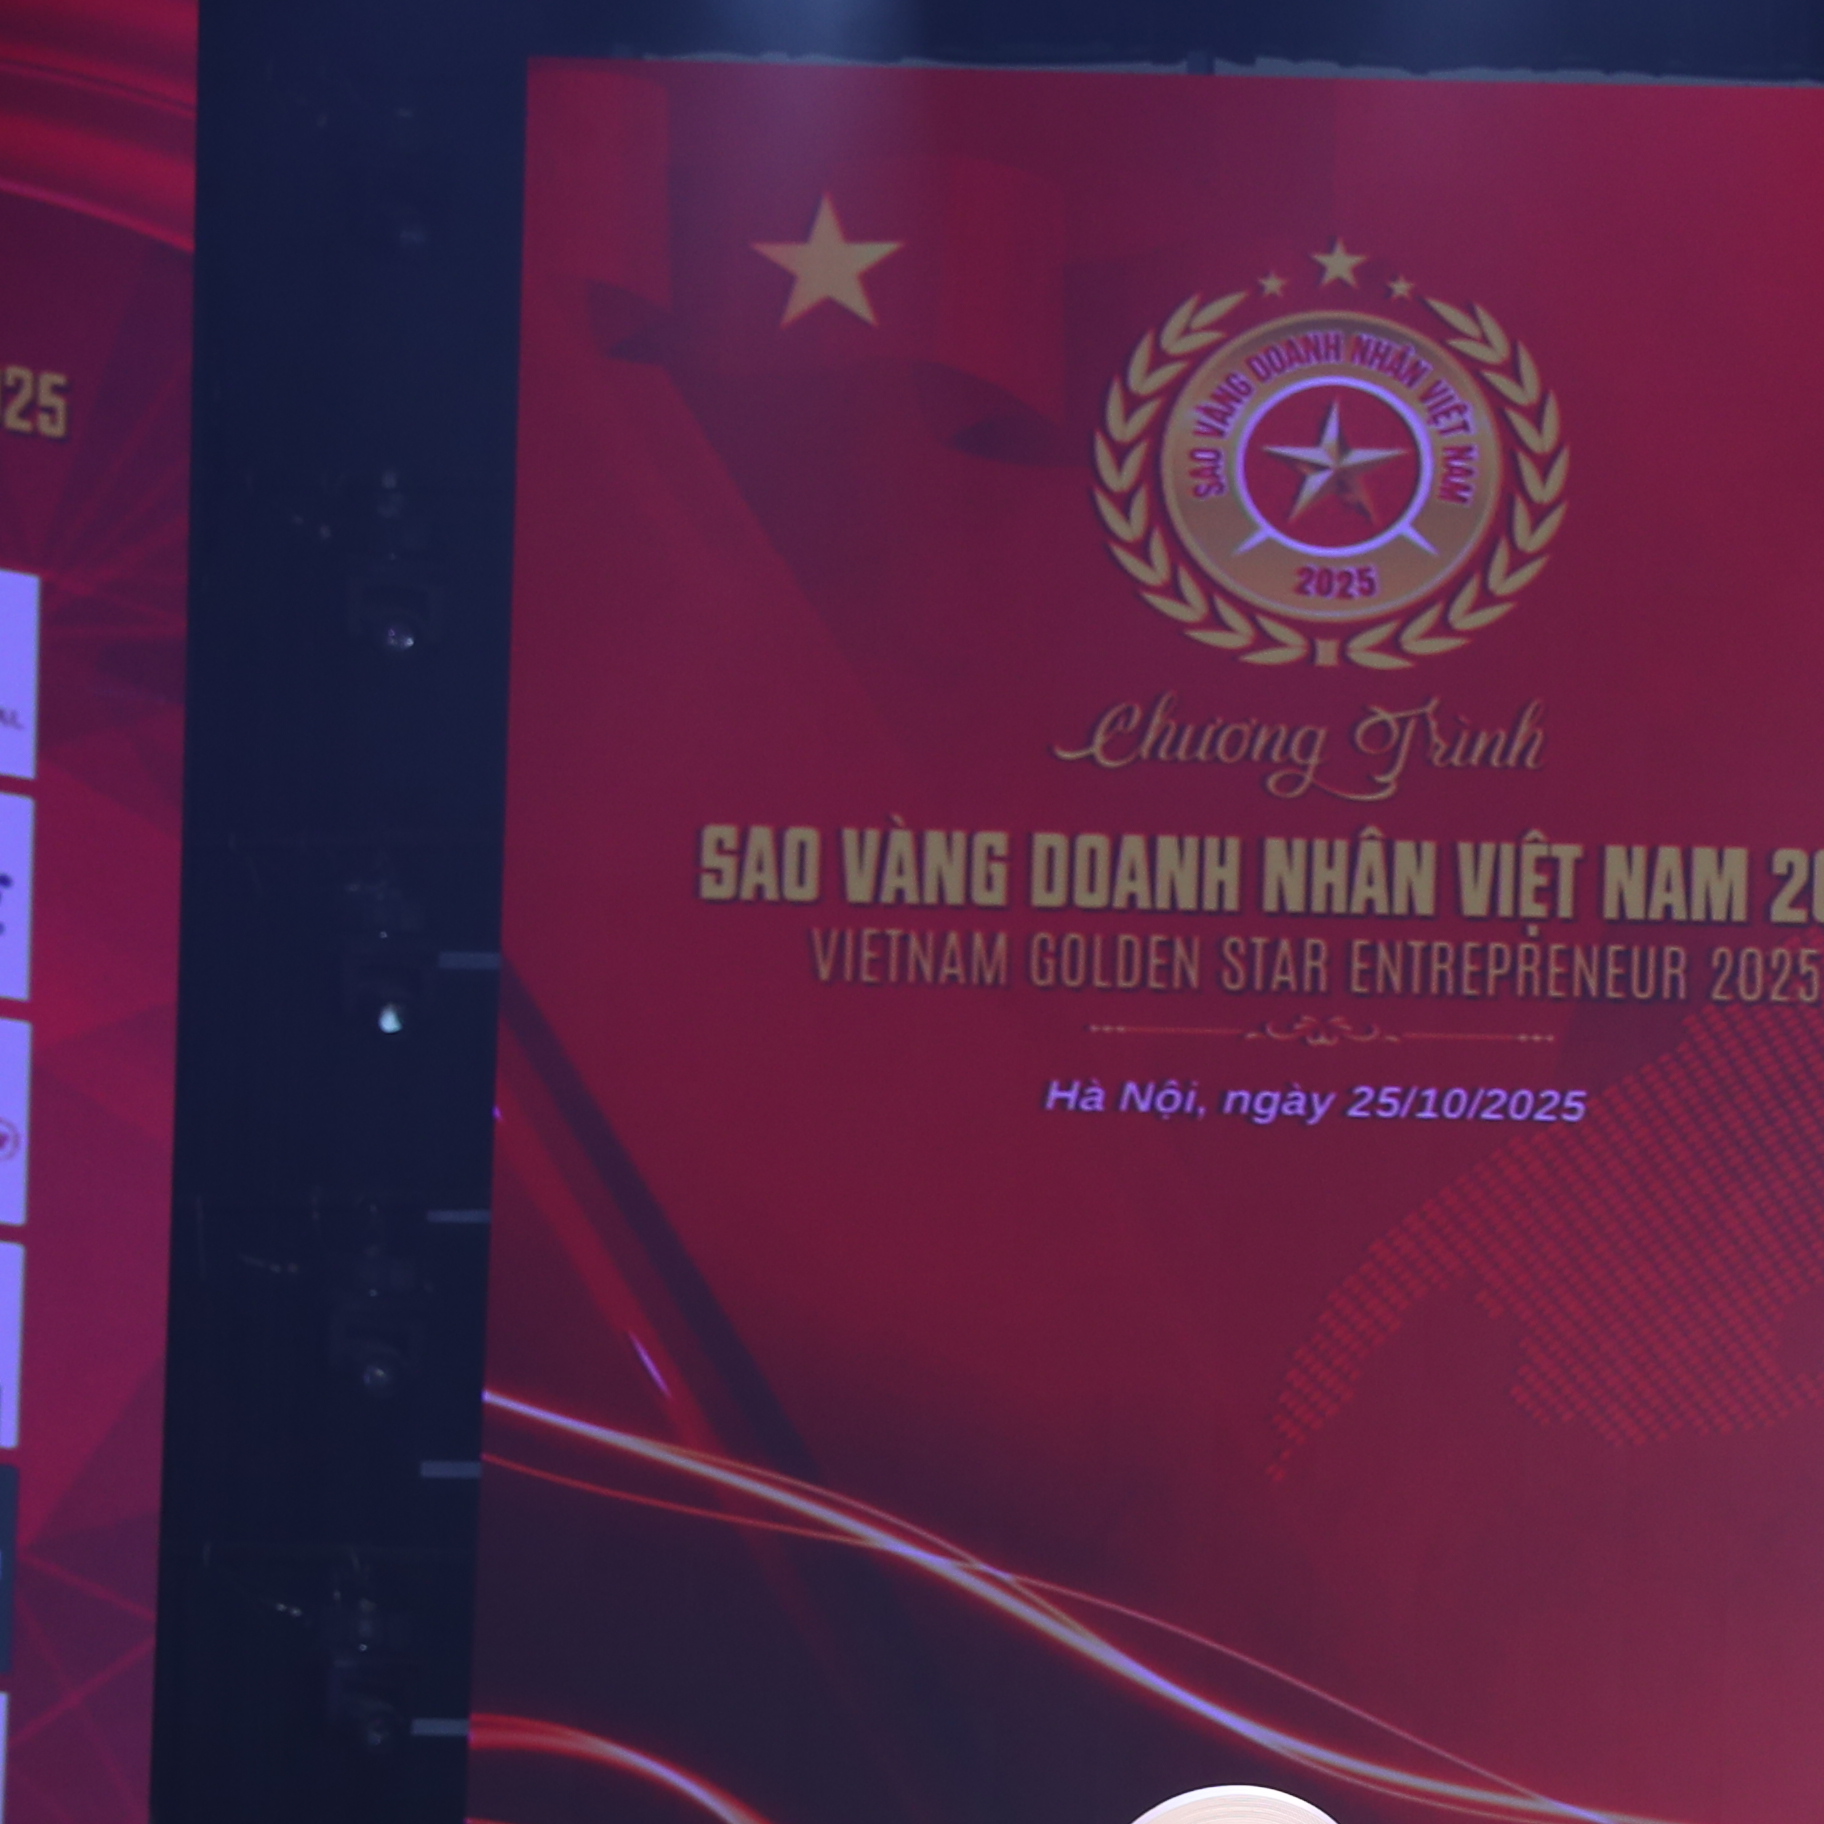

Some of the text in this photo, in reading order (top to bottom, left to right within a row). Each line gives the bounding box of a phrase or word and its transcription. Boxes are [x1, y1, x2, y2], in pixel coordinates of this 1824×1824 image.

[0, 365, 67, 438] 25
[1189, 447, 1226, 498] SAO
[1245, 330, 1344, 384] DOANH
[1439, 444, 1478, 505] NAM
[1295, 564, 1378, 598] 2025
[1053, 692, 1545, 800] Chương Trình
[699, 823, 820, 901] SAO
[841, 812, 1009, 906] VÀNG
[1031, 832, 1240, 911] DOANH
[1262, 826, 1436, 916] NHÂN
[1457, 829, 1583, 938] VIỆT
[1604, 845, 1748, 923] NAM
[810, 927, 1820, 1001] VIETNAM GOLDEN STAR ENTREPRENEUR 2025
[1044, 1078, 1588, 1126] Hà Nội, ngày 25/10/2025
